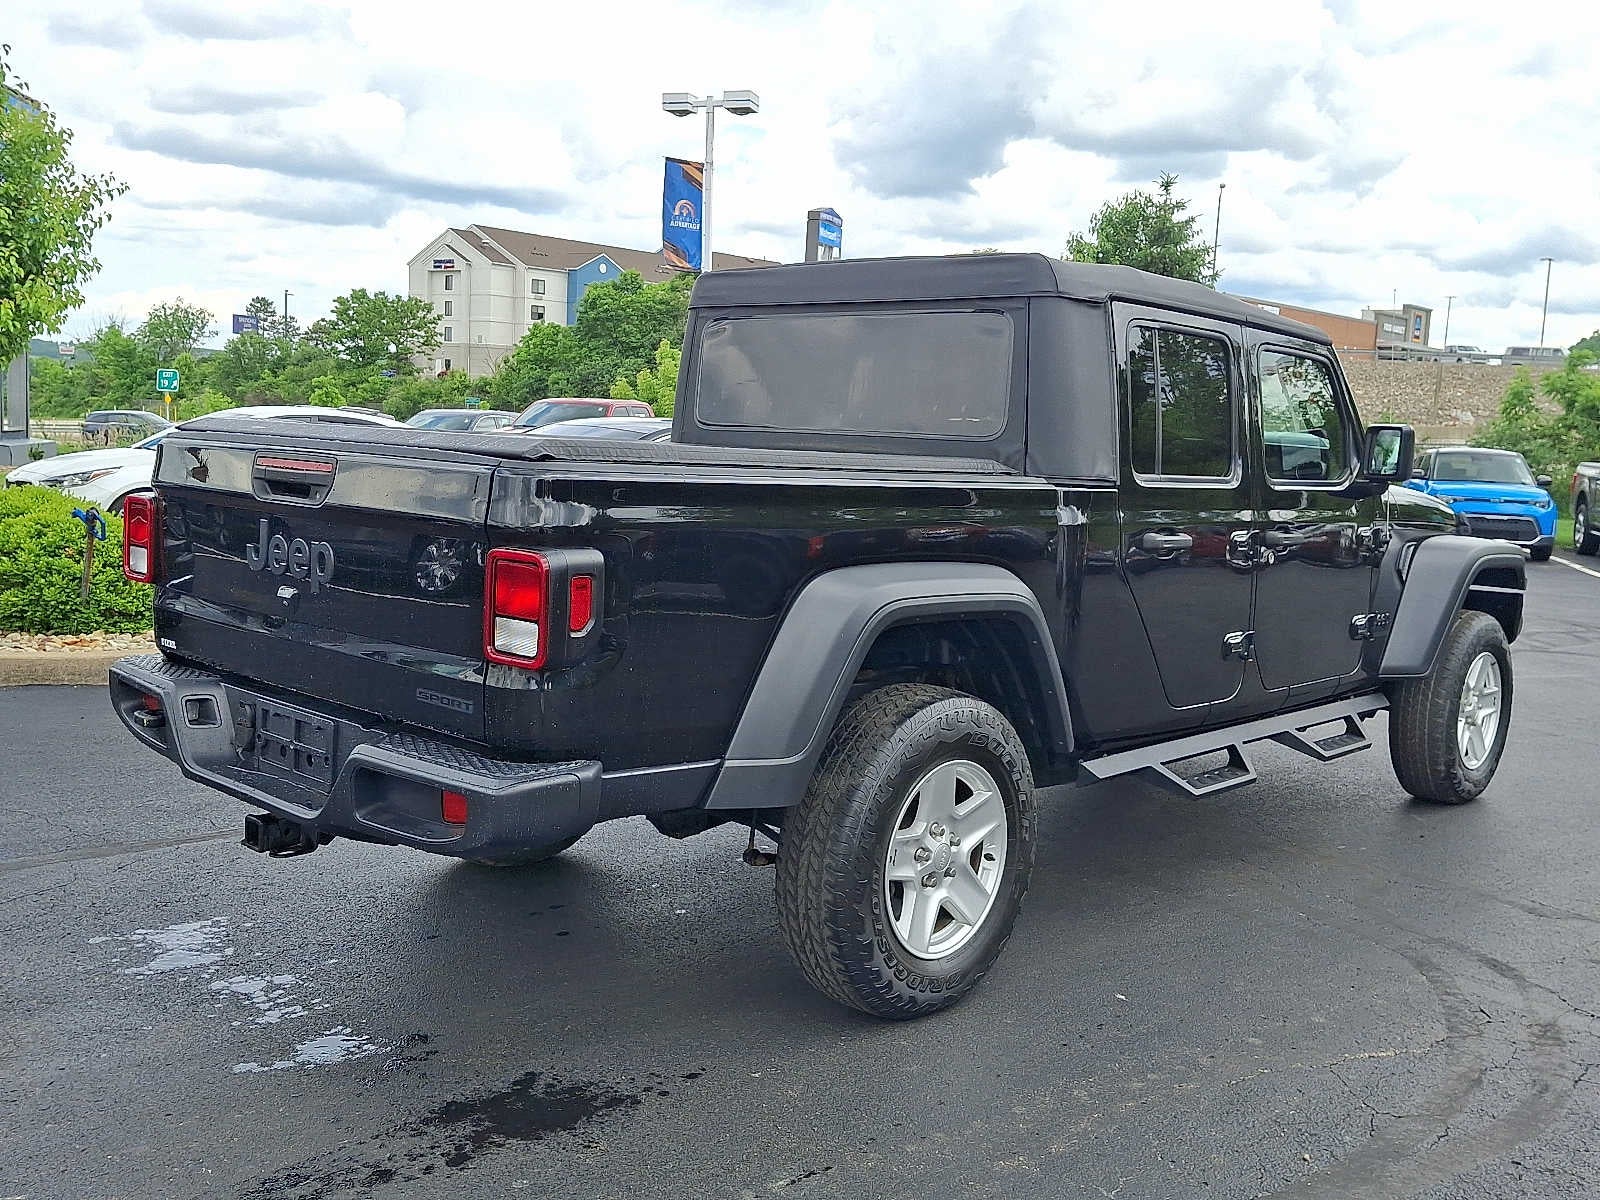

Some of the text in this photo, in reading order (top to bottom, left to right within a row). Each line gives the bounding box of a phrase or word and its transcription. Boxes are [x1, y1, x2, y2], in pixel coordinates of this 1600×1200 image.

[160, 379, 168, 388] 19
[246, 519, 334, 593] Jeep
[416, 688, 473, 713] SPORT
